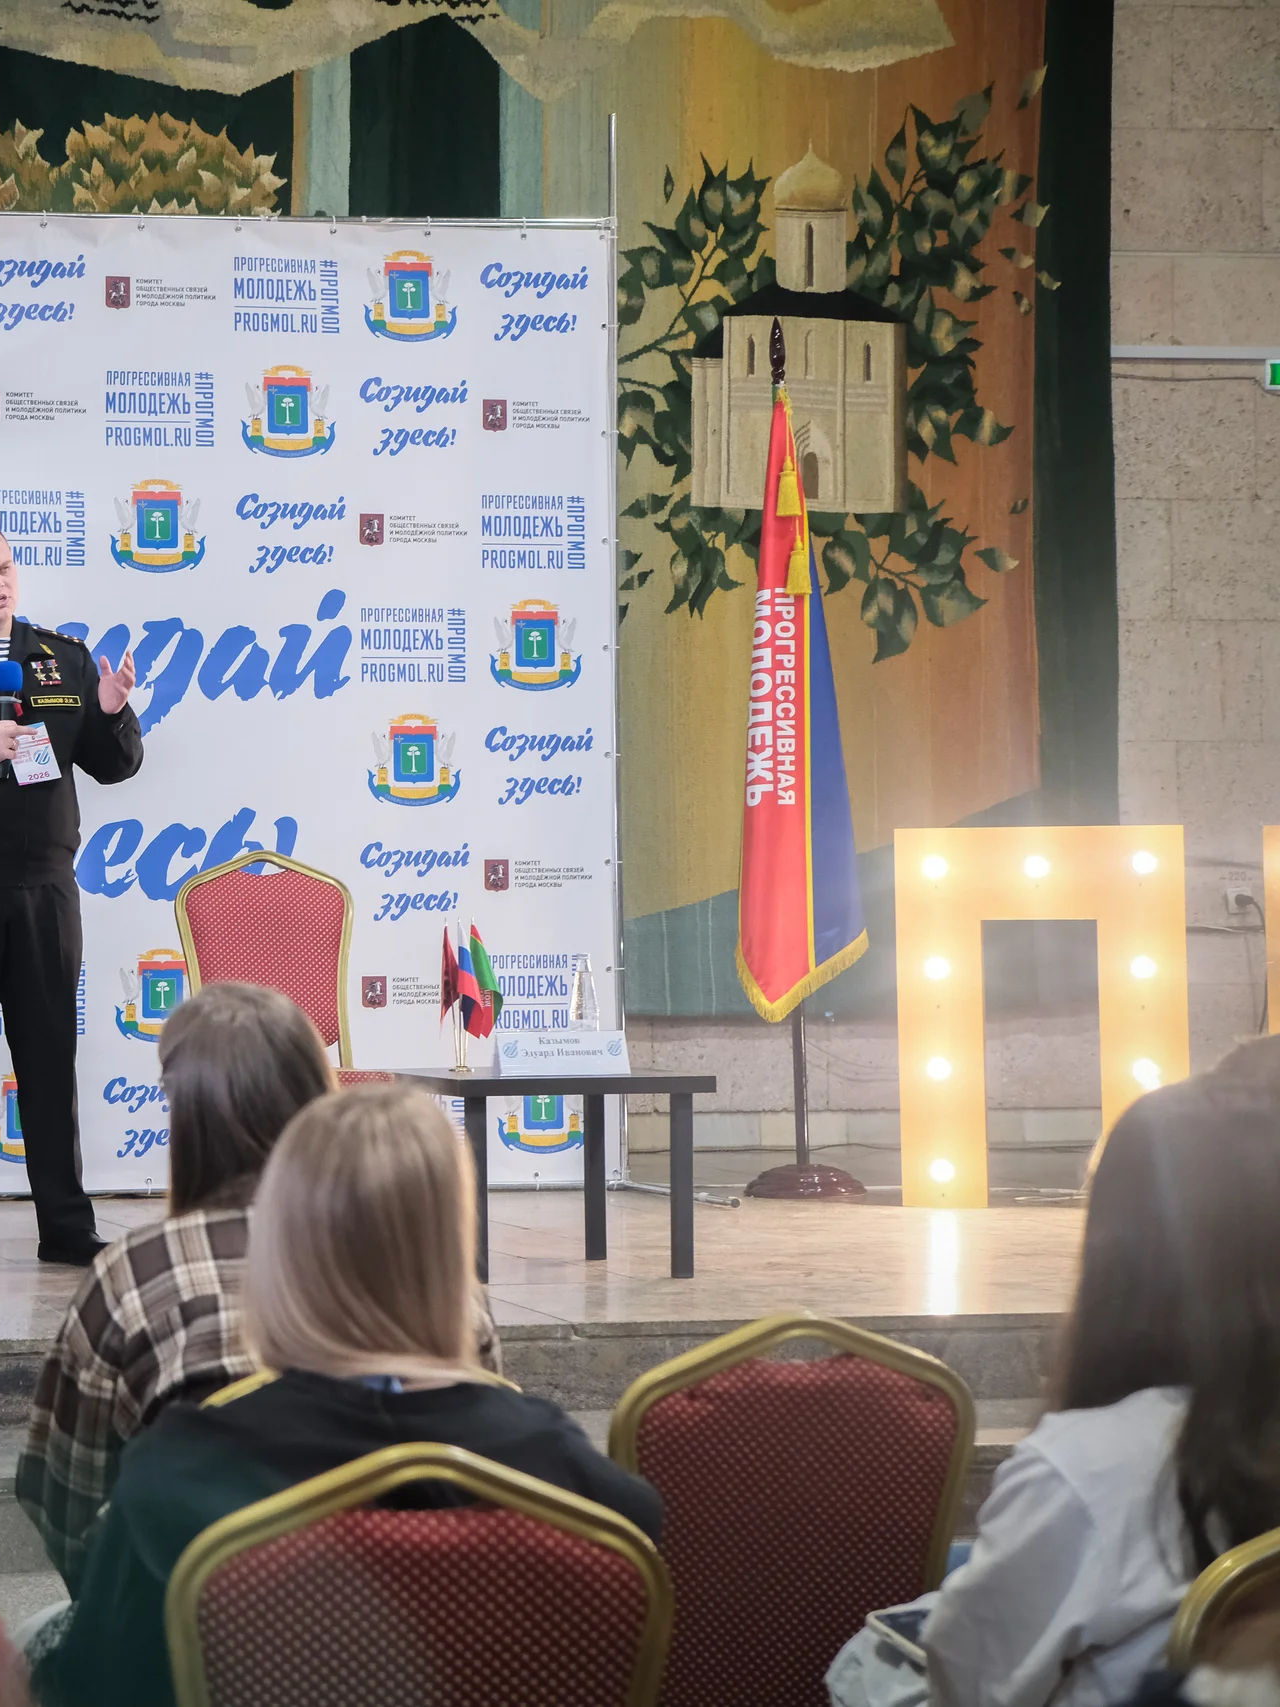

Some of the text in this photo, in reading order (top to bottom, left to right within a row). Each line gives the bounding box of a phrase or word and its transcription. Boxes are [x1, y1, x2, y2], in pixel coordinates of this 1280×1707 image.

[234, 257, 317, 273] ПРОГРЕССИВНАЯ
[234, 278, 316, 302] МОЛОДЕЖЬ
[481, 262, 588, 298] Созидай
[317, 260, 340, 334] #ПРОГМОЛ
[234, 312, 318, 333] PROGMOL.RU
[494, 312, 577, 341] здесь!
[107, 370, 191, 386] ПРОГРЕССИВНАЯ
[106, 392, 191, 416] МОЛОДЕЖЬ
[360, 376, 468, 413] Созидай
[11, 406, 54, 414] МОЛОДЁЖНОЙ
[195, 372, 215, 447] #ПРОГМОЛ
[106, 426, 192, 446] PROGMOL.RU
[373, 427, 456, 456] здесь!
[236, 493, 346, 530] Созидай
[482, 495, 564, 510] ПРОГРЕССИВНАЯ
[66, 491, 85, 566] #ПРОГМОЛ
[482, 515, 563, 538] МОЛОДЕЖЬ
[568, 496, 586, 569] #ПРОГМОЛ
[13, 546, 62, 566] MOL.RU
[249, 544, 334, 573] здесь!
[482, 549, 564, 568] PROGMOL.RU
[361, 608, 444, 622] ПРОГРЕССИВНАЯ
[361, 628, 444, 652] МОЛОДЕЖЬ
[448, 609, 466, 682] #ПРОГМОЛ
[362, 663, 444, 682] PROGMOL.RU
[485, 726, 593, 761] Созидай
[28, 771, 50, 780] 2026
[499, 775, 582, 804] здесь!
[360, 842, 470, 877] Созидай
[374, 890, 458, 920] здесь!
[498, 975, 568, 999] ОЛОДЕЖЬ
[495, 1009, 568, 1029] ROGMOL.RU
[520, 1048, 603, 1058] Эдуард Иванович
[539, 1037, 580, 1045] Казымов
